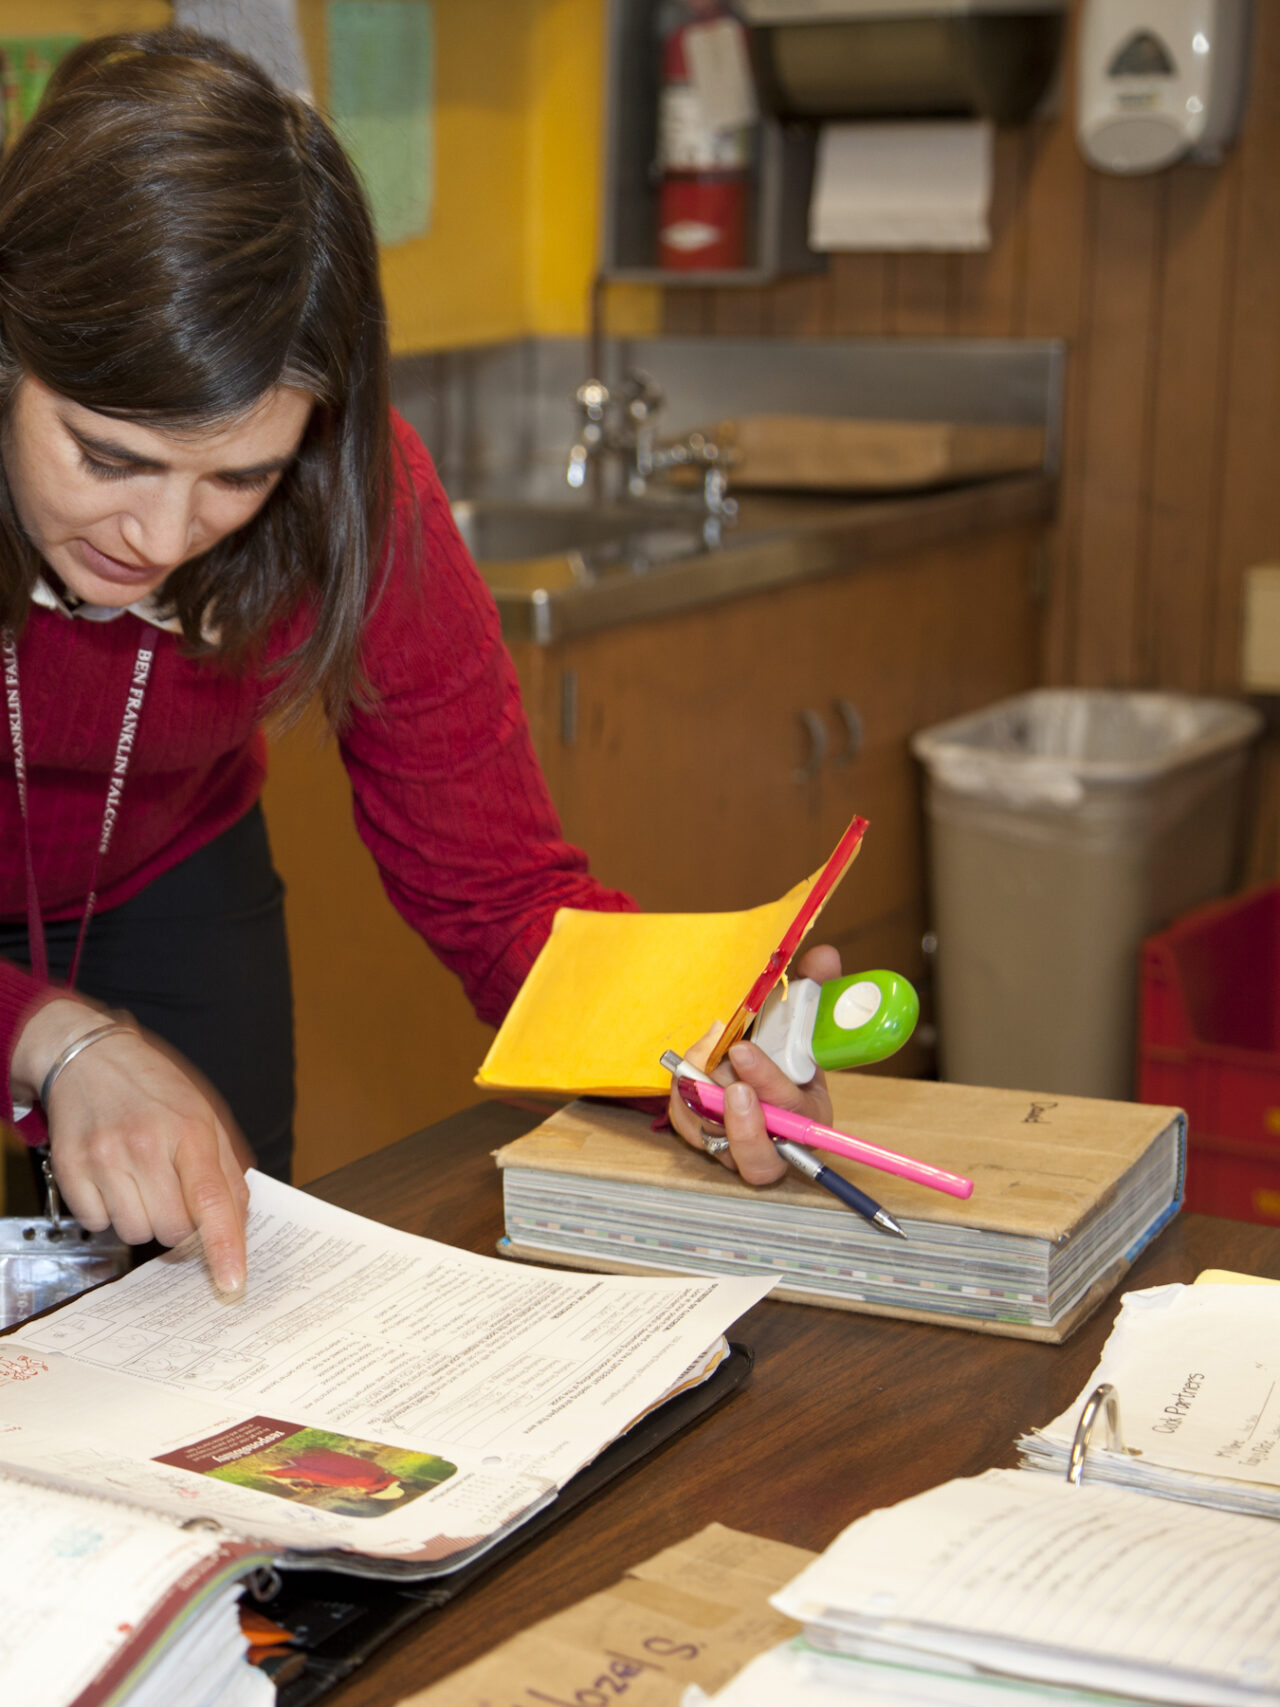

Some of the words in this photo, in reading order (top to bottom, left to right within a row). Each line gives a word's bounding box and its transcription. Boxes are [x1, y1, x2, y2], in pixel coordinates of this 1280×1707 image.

[132, 648, 153, 685] BEN
[113, 686, 145, 775] FRANKLIN
[1164, 1372, 1205, 1417] Partners
